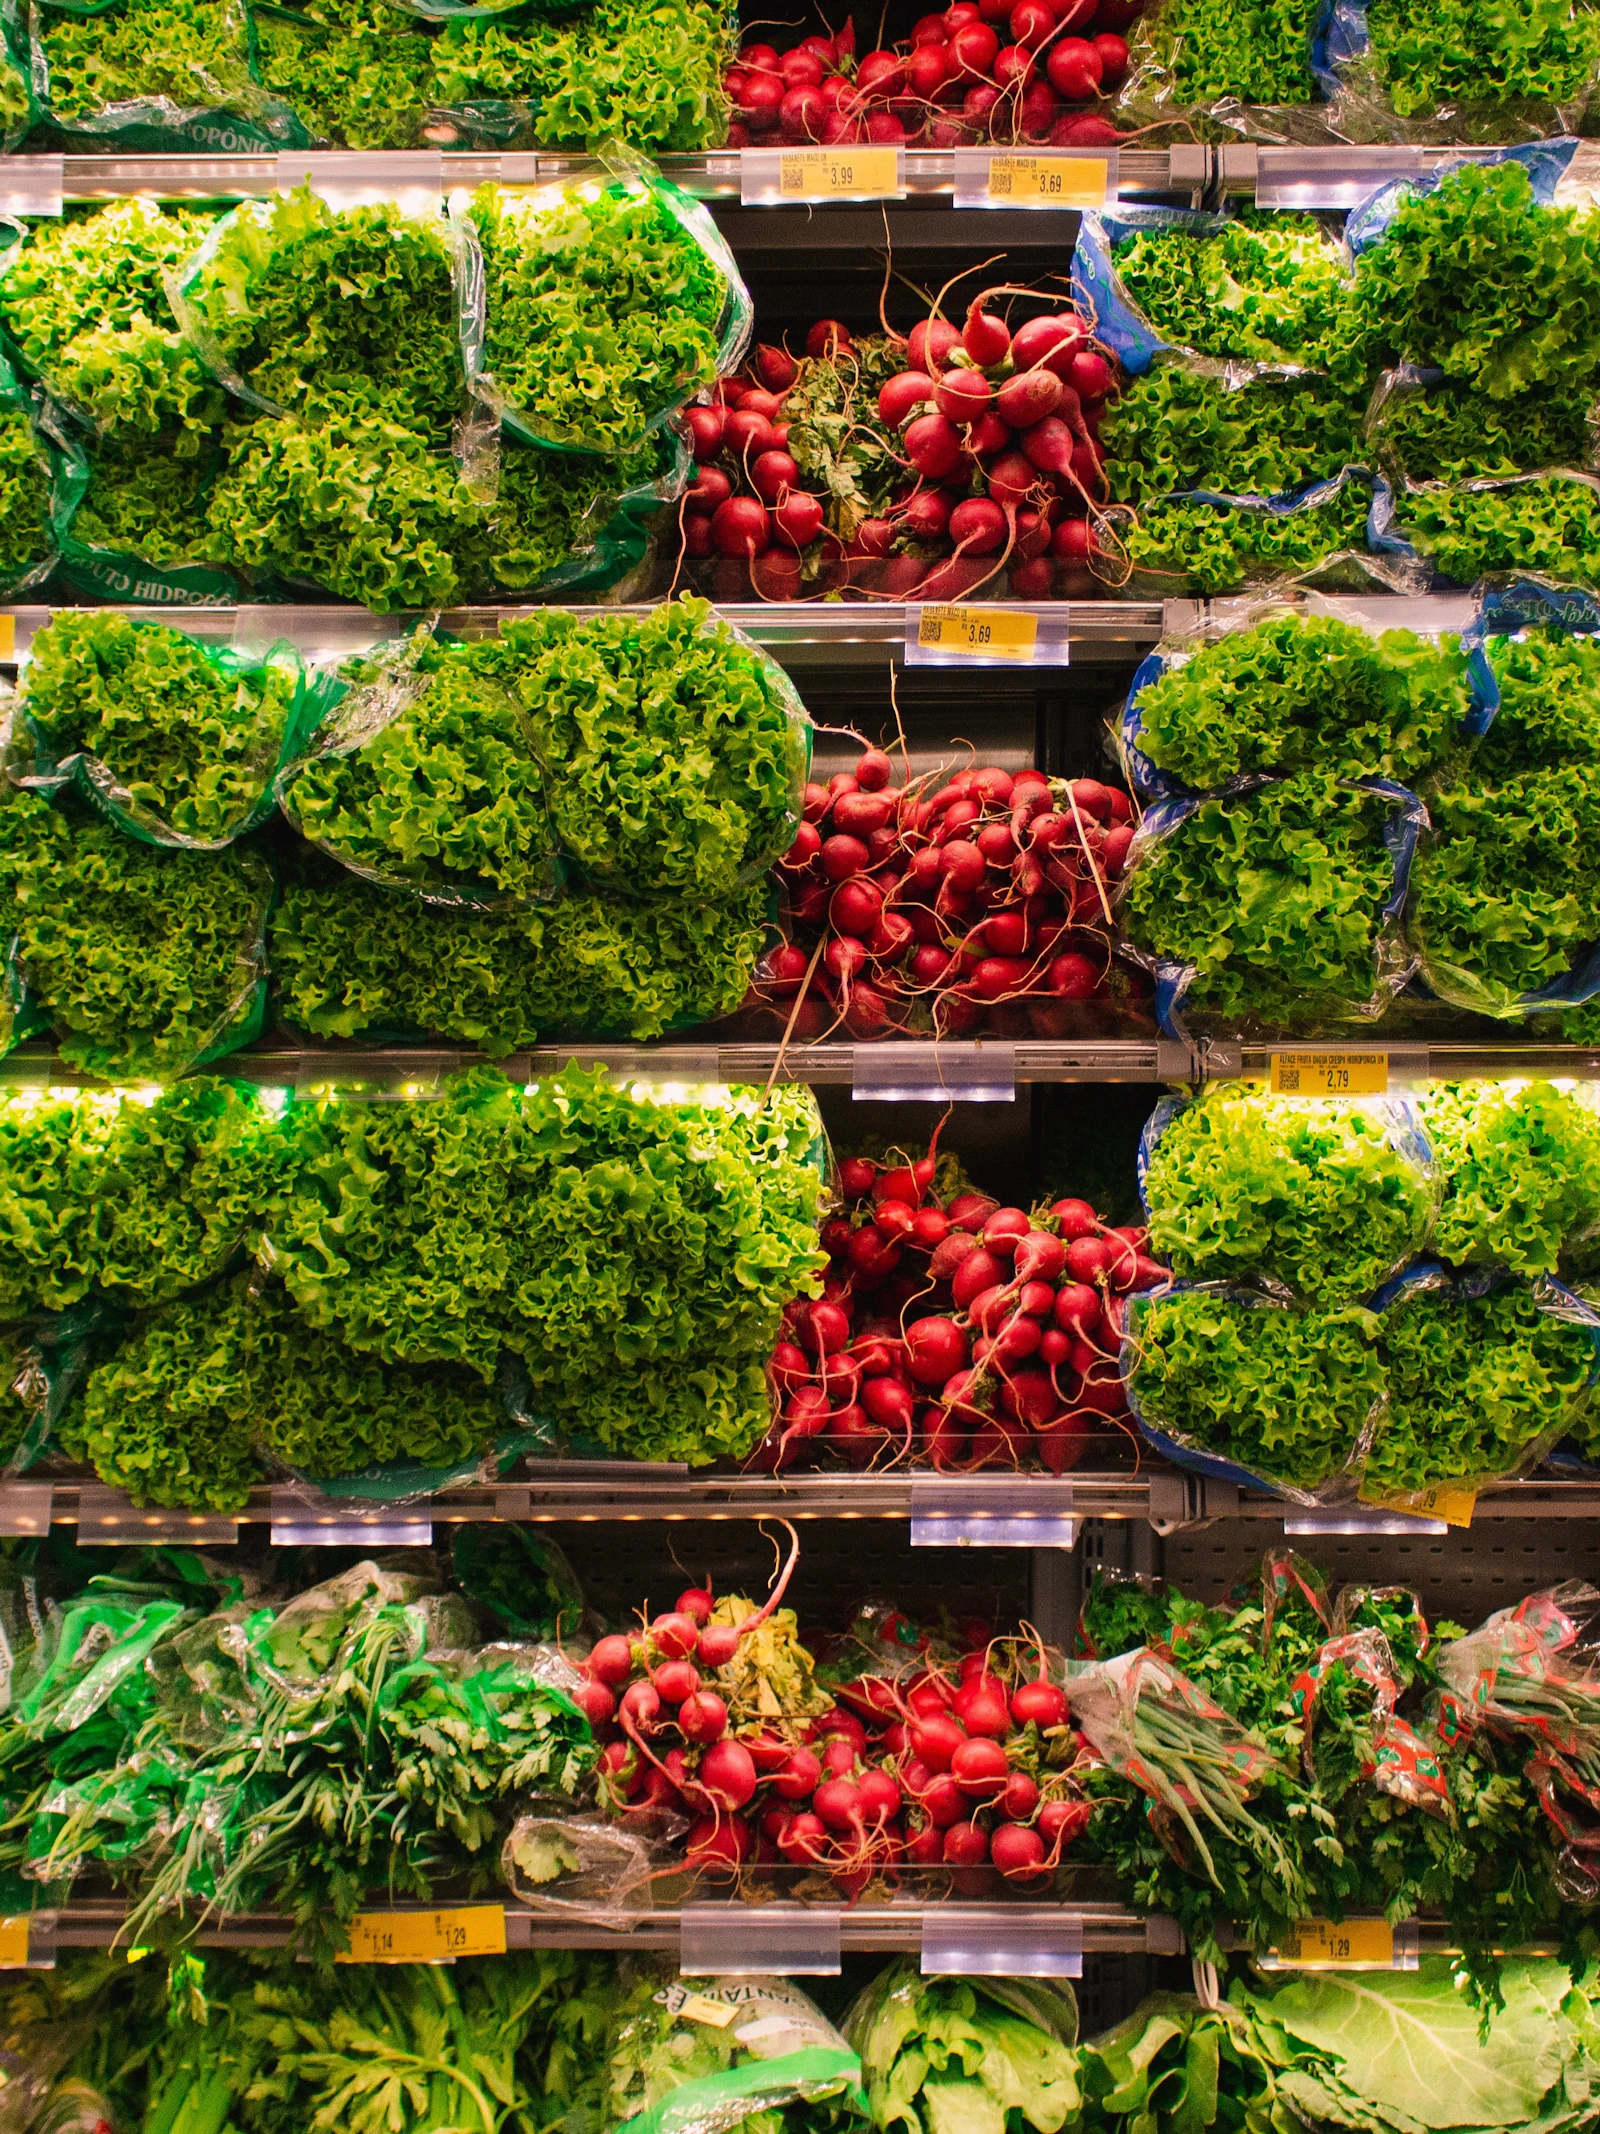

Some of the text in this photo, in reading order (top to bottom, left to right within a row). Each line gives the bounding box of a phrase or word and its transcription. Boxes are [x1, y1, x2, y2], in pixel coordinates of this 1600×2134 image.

[831, 166, 853, 187] 3,99
[1039, 174, 1062, 195] 3,69
[968, 624, 991, 645] 3,69
[1327, 1070, 1349, 1090] 2,79
[372, 1933, 393, 1952] 1,14
[445, 1927, 466, 1948] 1,29
[1329, 1939, 1350, 1958] 1,29
